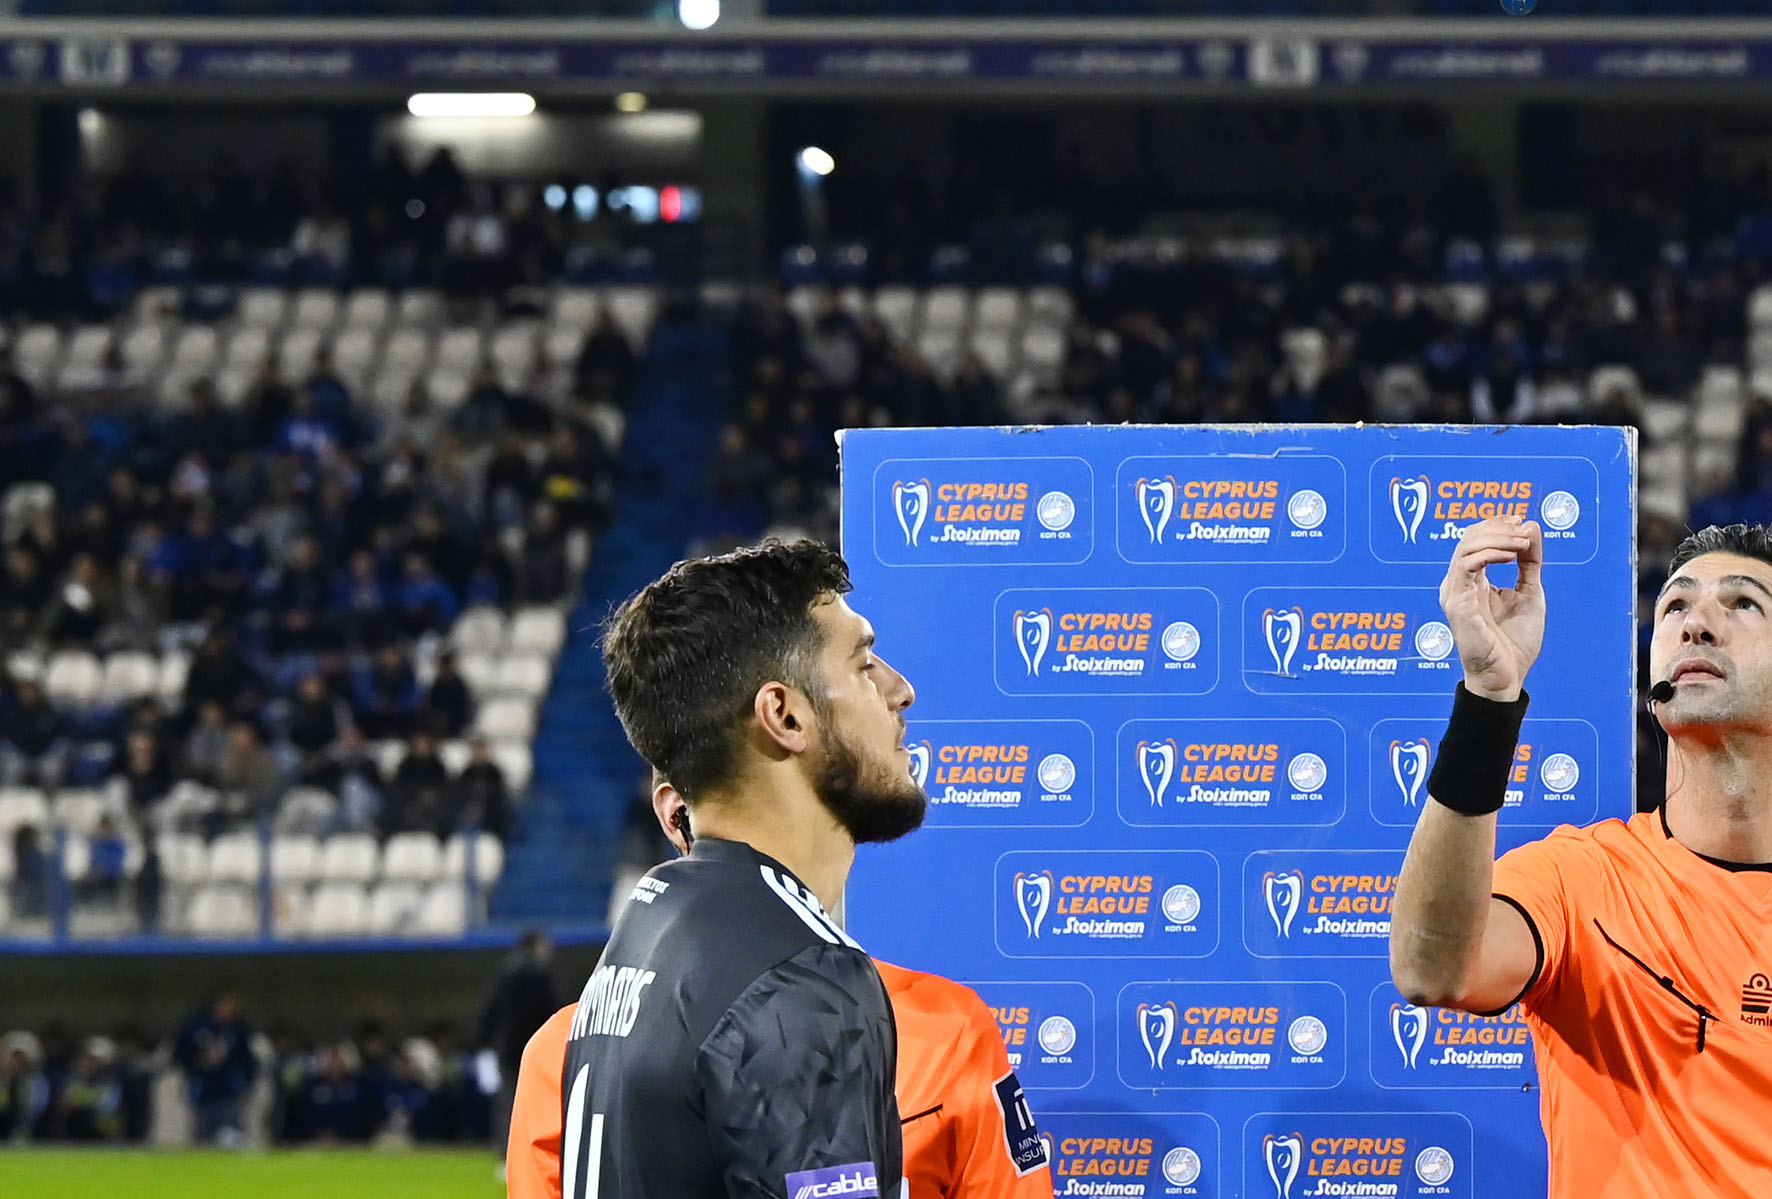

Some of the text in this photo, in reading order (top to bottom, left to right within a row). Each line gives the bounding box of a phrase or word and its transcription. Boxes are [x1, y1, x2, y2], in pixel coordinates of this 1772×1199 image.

[939, 483, 1027, 500] CYPRUS
[1185, 481, 1278, 498] CYPRUS
[936, 504, 1025, 521] LEAGUE
[1181, 502, 1275, 519] LEAGUE
[940, 525, 1021, 543] Stoiximan
[1186, 522, 1270, 540] Stoiximan
[1061, 614, 1152, 630] CYPRUS
[1312, 613, 1405, 629] CYPRUS
[1058, 634, 1149, 651] LEAGUE
[1308, 634, 1403, 650] LEAGUE
[1062, 655, 1145, 673] Stoiximan
[1313, 654, 1398, 672] Stoiximan
[940, 746, 1028, 762] CYPRUS
[1185, 745, 1278, 761] CYPRUS
[936, 767, 1026, 783] LEAGUE
[1182, 765, 1275, 782] LEAGUE
[941, 787, 1021, 805] Stoiximan
[1187, 786, 1271, 804] Stoiximan
[1061, 876, 1152, 892] CYPRUS
[1058, 897, 1149, 913] LEAGUE
[1063, 917, 1145, 935] Stoiximan
[1186, 1008, 1278, 1024] CYPRUS
[1182, 1028, 1275, 1044] LEAGUE
[1187, 1048, 1271, 1066] Stoiximan
[1062, 1138, 1153, 1155] CYPRUS
[1312, 1138, 1405, 1155] CYPRUS
[1058, 1159, 1150, 1176] LEAGUE
[1309, 1159, 1403, 1176] LEAGUE
[1063, 1179, 1145, 1197] Stoiximan
[1314, 1179, 1398, 1197] Stoiximan
